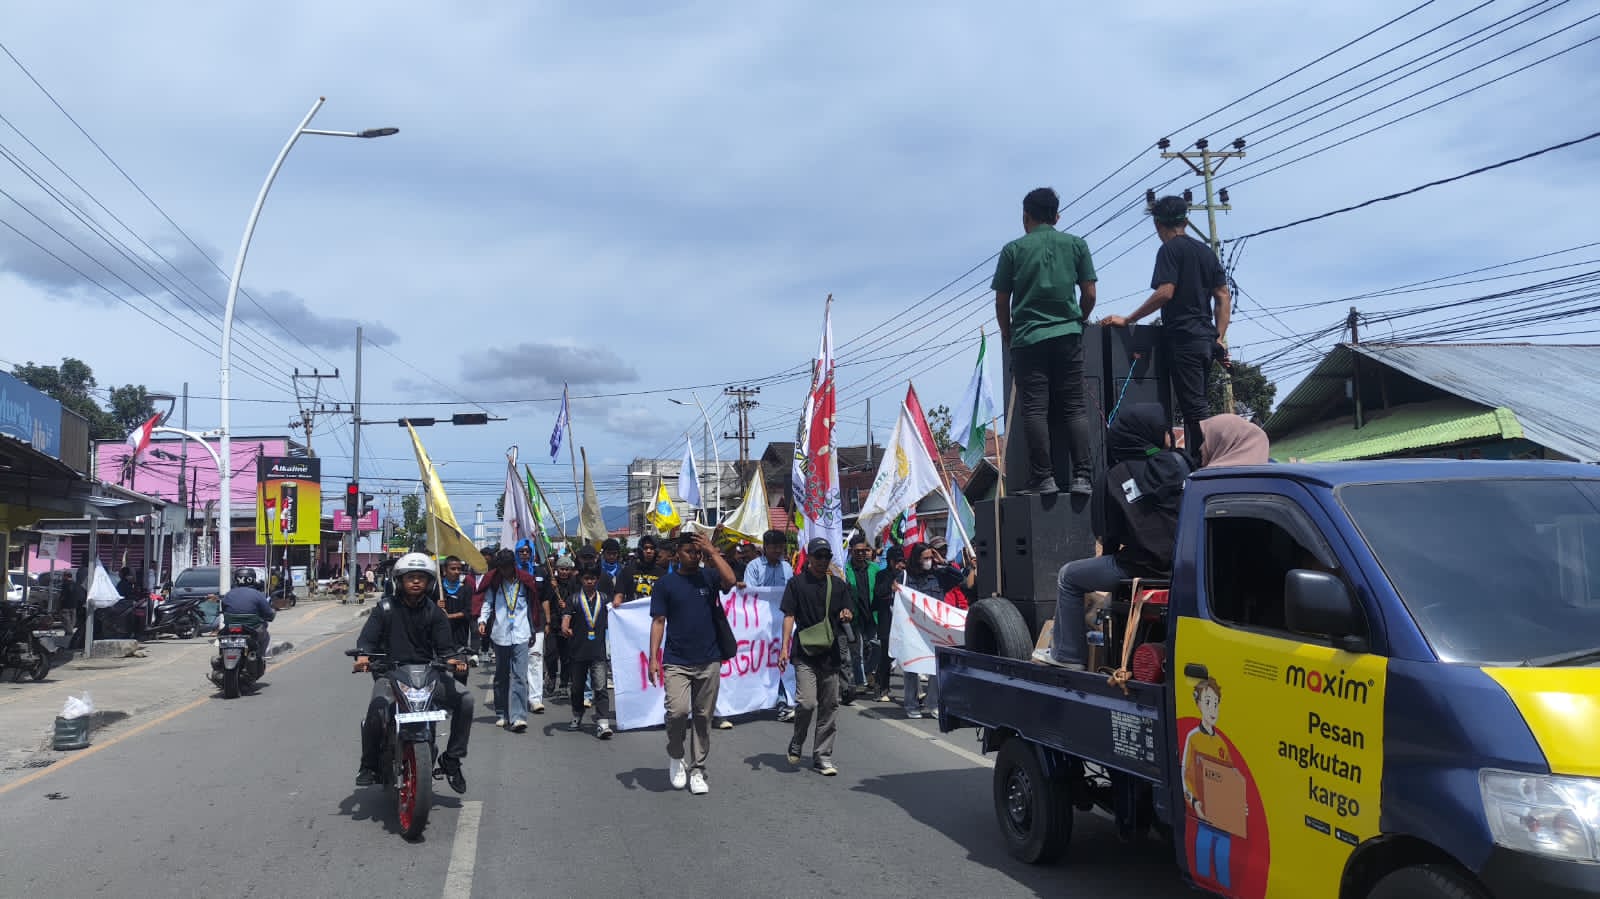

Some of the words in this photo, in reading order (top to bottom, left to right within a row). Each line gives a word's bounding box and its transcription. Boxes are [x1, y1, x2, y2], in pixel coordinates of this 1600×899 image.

[271, 463, 308, 472] Alkaline
[1308, 711, 1364, 750] Pesan
[1278, 740, 1362, 784] angkutan
[1309, 776, 1360, 817] kargo
